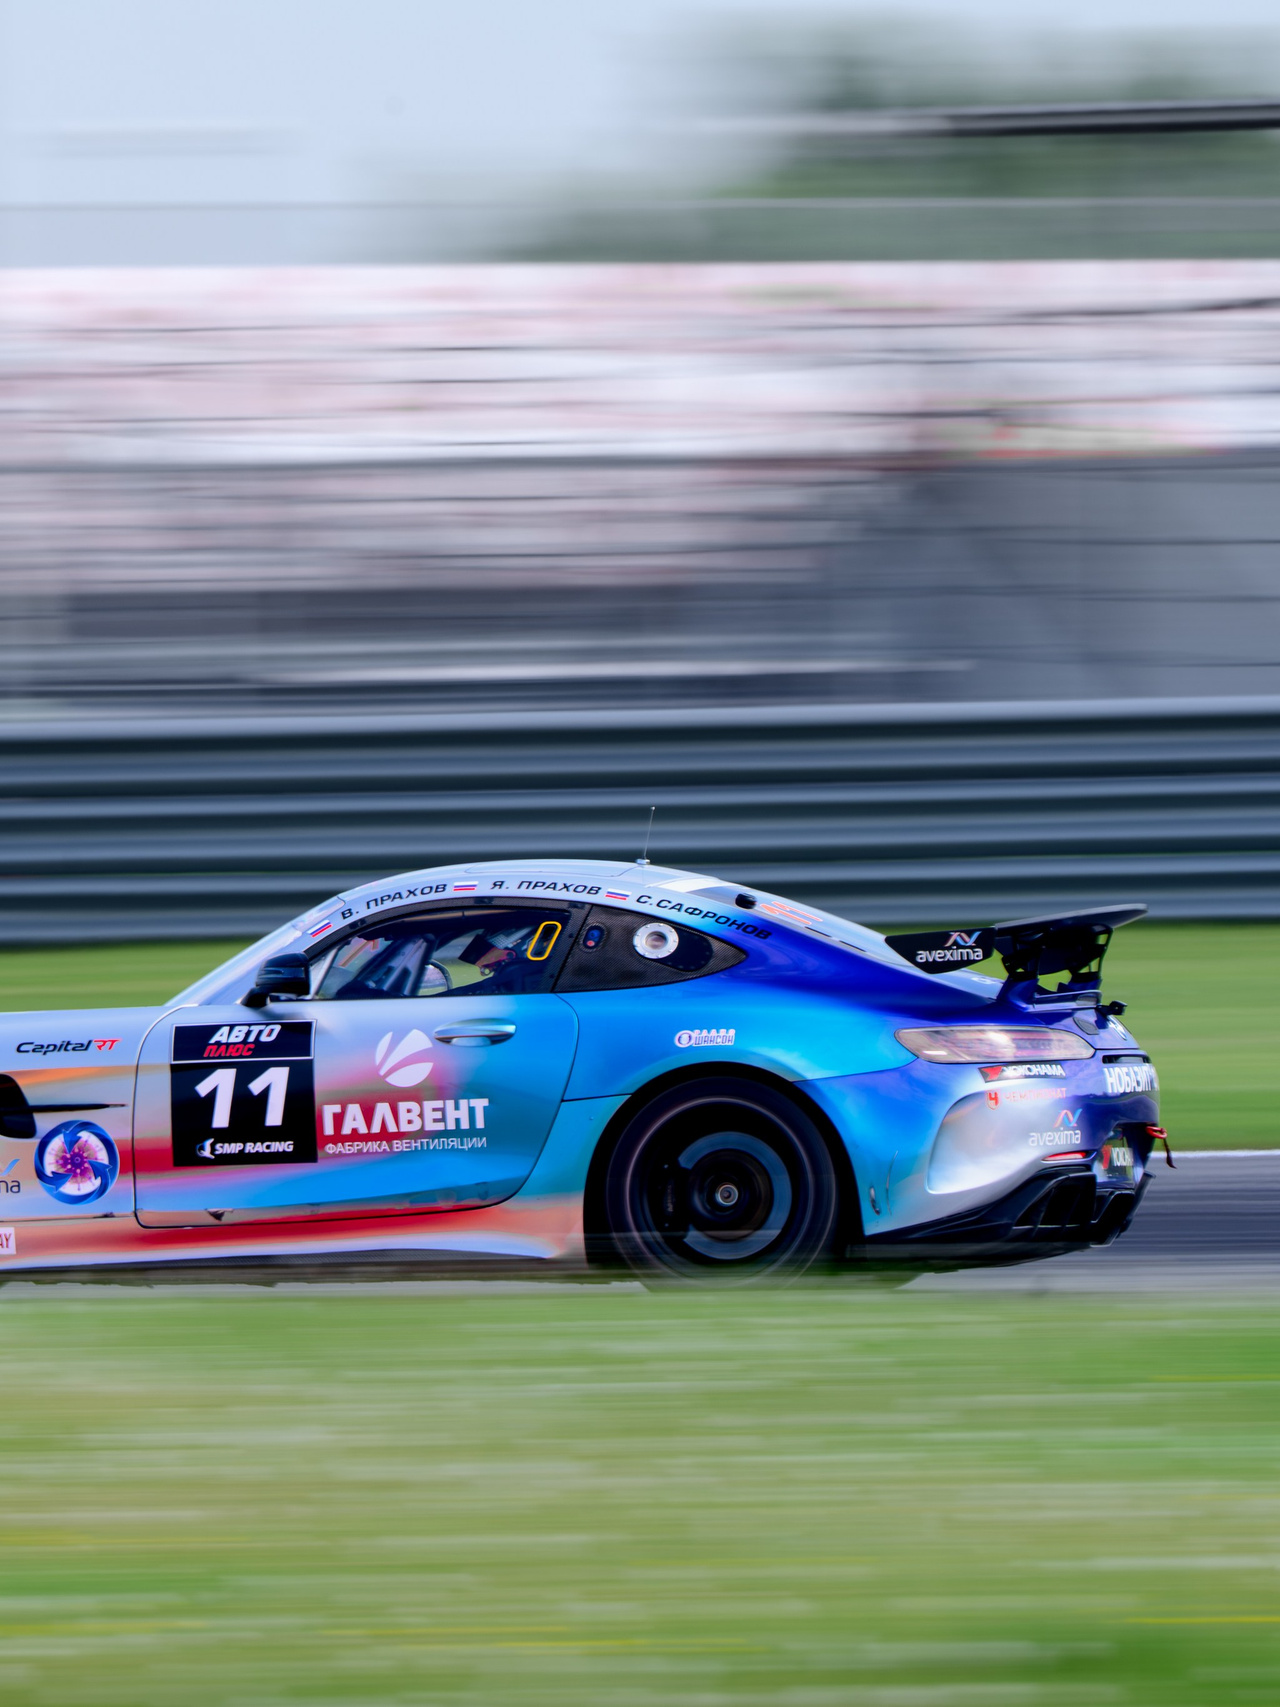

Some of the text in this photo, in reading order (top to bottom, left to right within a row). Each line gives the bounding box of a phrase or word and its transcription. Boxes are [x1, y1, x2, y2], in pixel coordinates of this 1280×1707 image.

[490, 880, 602, 896] Я. ПРАХОВ
[340, 883, 447, 920] В. ПРАХОВ
[915, 946, 984, 962] avexima
[208, 1024, 282, 1044] АВТО
[203, 1044, 256, 1057] ПЛЮС
[1003, 1064, 1066, 1077] YOKOHAMA
[194, 1067, 290, 1128] 11
[322, 1098, 489, 1136] ГАЛВЕНТ
[1029, 1127, 1082, 1146] avexima
[214, 1141, 294, 1155] SMP RACING
[324, 1137, 487, 1155] ФАБРИКА ВЕНТИЛЯЦИИ
